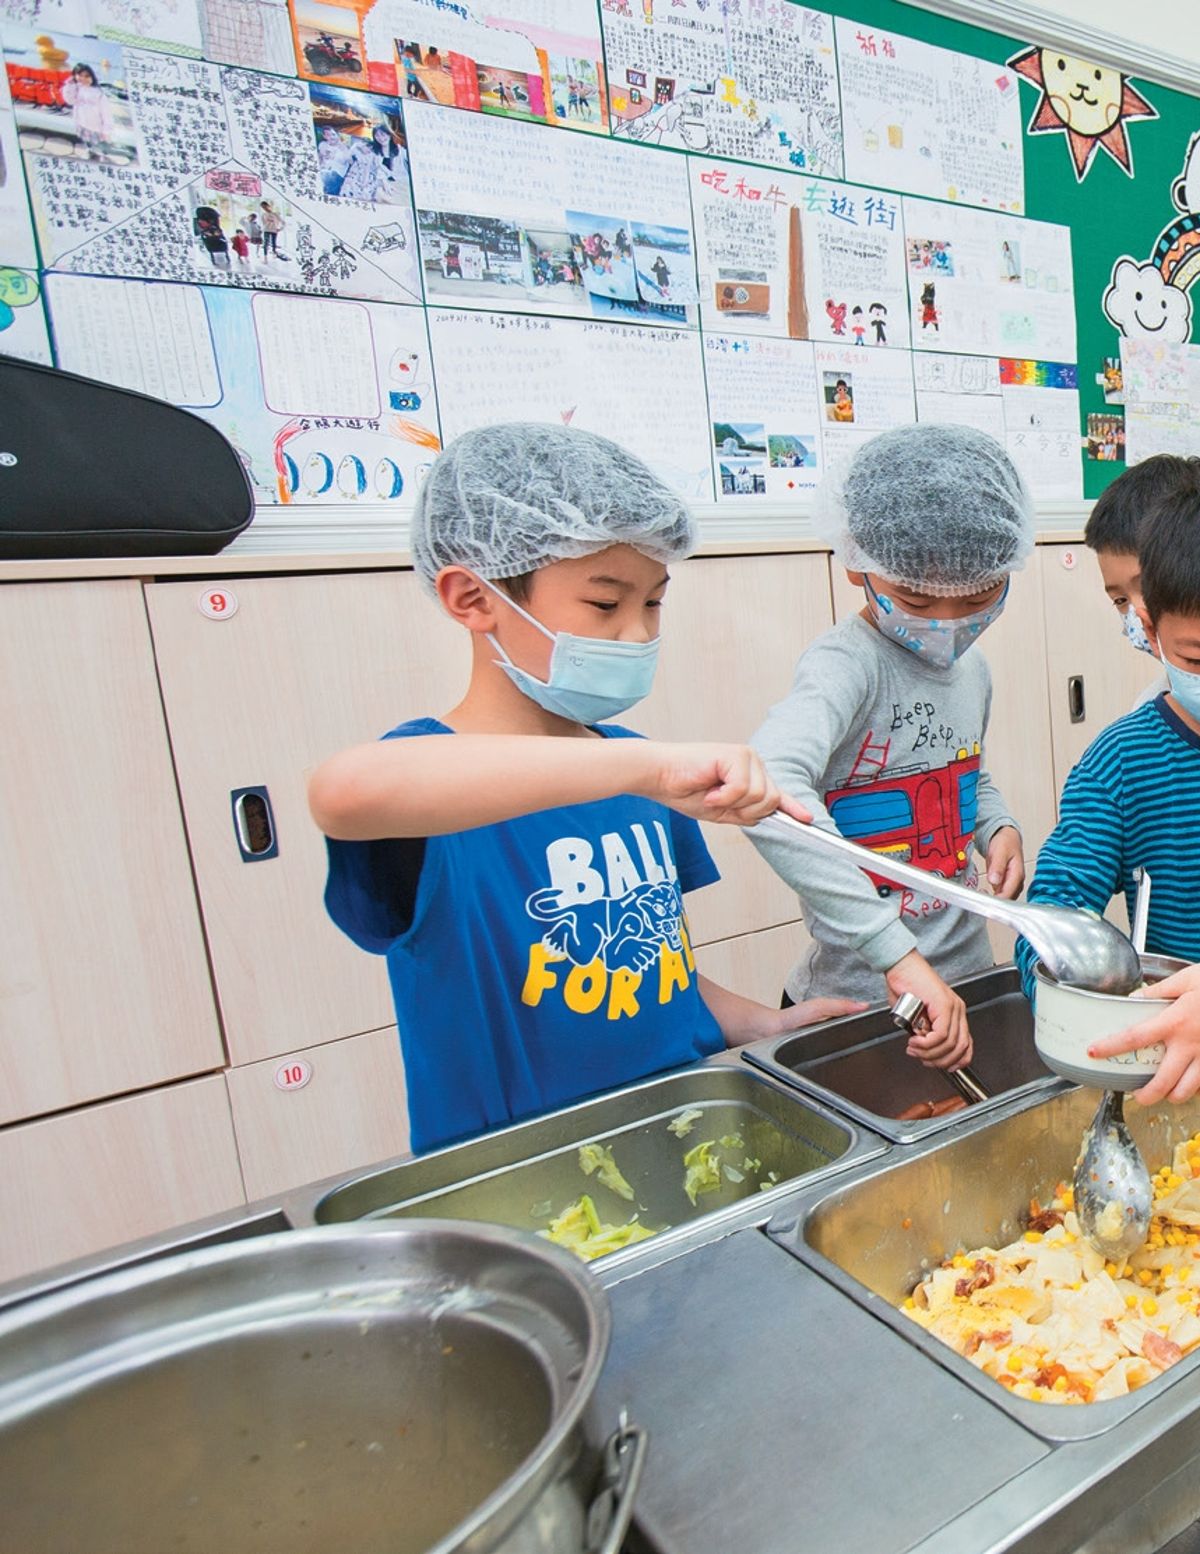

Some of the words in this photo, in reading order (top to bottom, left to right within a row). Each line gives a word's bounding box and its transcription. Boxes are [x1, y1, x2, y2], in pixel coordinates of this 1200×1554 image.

[856, 31, 896, 59] 祈福
[700, 169, 789, 213] 吃和牛
[803, 182, 897, 231] 去逛街
[1064, 552, 1073, 565] 3
[210, 594, 226, 612] 9
[890, 701, 936, 732] Beep
[546, 820, 679, 906] BALL
[521, 943, 643, 1020] FOR
[284, 1066, 301, 1084] 10
